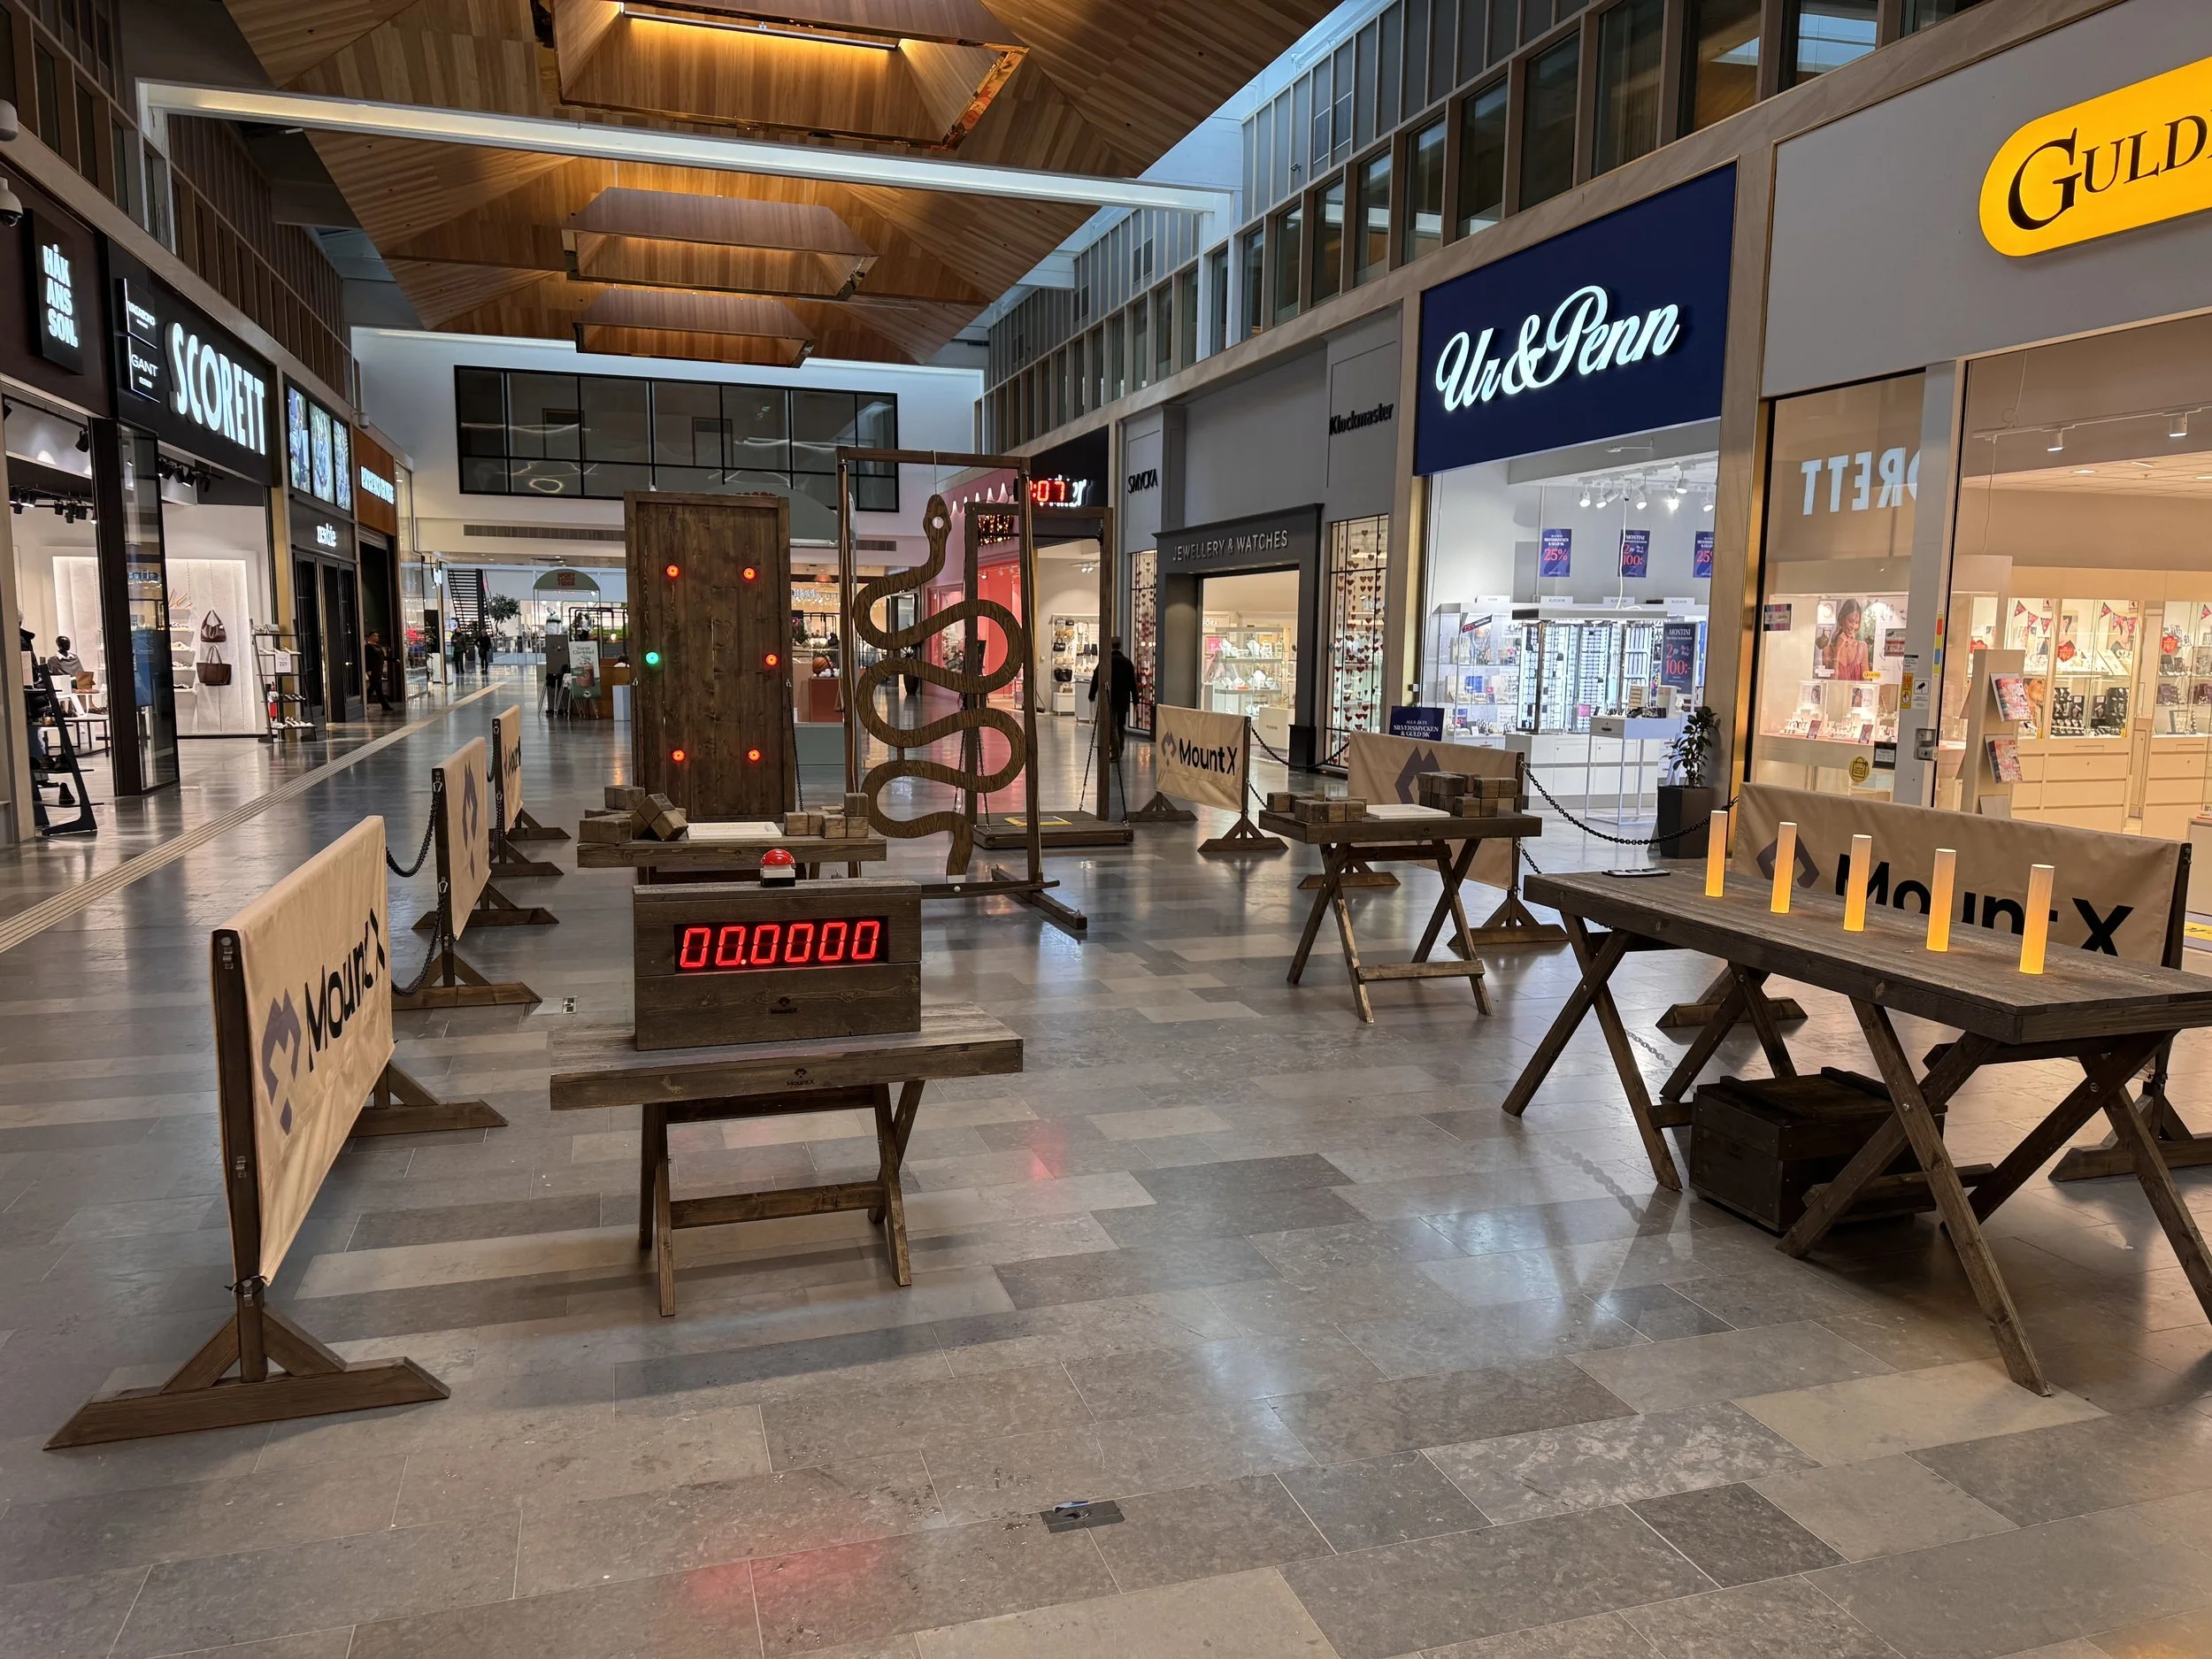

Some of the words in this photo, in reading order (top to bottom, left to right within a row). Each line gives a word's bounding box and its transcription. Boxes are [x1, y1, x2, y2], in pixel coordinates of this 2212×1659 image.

[2008, 109, 2212, 231] GULD
[42, 243, 71, 288] HÅK
[47, 277, 73, 316] ANS
[131, 354, 158, 377] GANT
[171, 322, 266, 456] SCORETT
[1329, 403, 1394, 436] Klockmaster
[1127, 468, 1158, 494] SMYCKA
[1172, 539, 1225, 562] JEWELLERY
[1227, 540, 1234, 555] &
[1236, 529, 1288, 551] WATCHES
[1544, 548, 1568, 562] 25%
[1666, 643, 1673, 658] 2
[1666, 659, 1692, 675] 100:-
[1393, 724, 1440, 733] SILVERSMYCKEN
[680, 920, 879, 968] 00.0000
